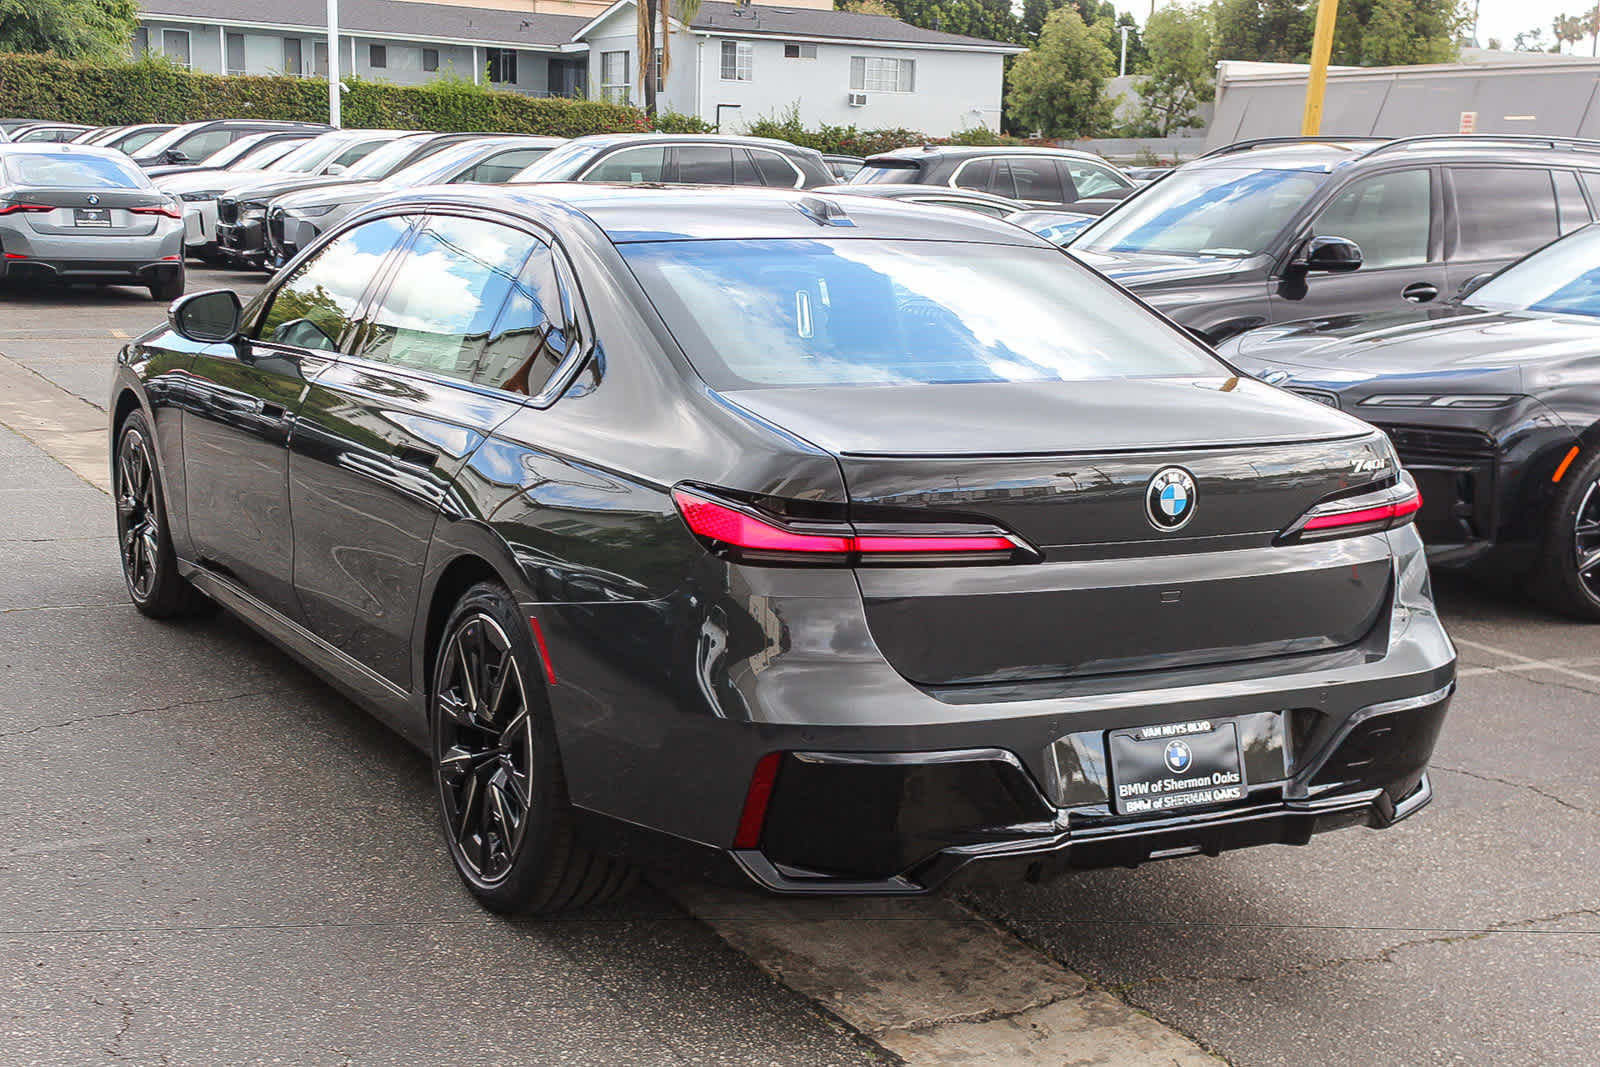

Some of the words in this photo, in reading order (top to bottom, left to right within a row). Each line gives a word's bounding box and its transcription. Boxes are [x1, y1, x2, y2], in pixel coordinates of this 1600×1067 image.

[1351, 459, 1385, 473] 740i
[1154, 472, 1193, 491] BMW
[1142, 725, 1161, 738] VAN
[1162, 722, 1187, 735] NUYS
[1187, 720, 1212, 733] BLVD
[1119, 781, 1149, 797] BMW
[1151, 780, 1162, 793] of
[1163, 775, 1212, 791] Sherman
[1211, 771, 1240, 785] Oaks
[1126, 798, 1152, 812] BMW
[1152, 797, 1163, 809] of
[1163, 790, 1212, 807] SHERMAN
[1213, 787, 1240, 801] OAKS
